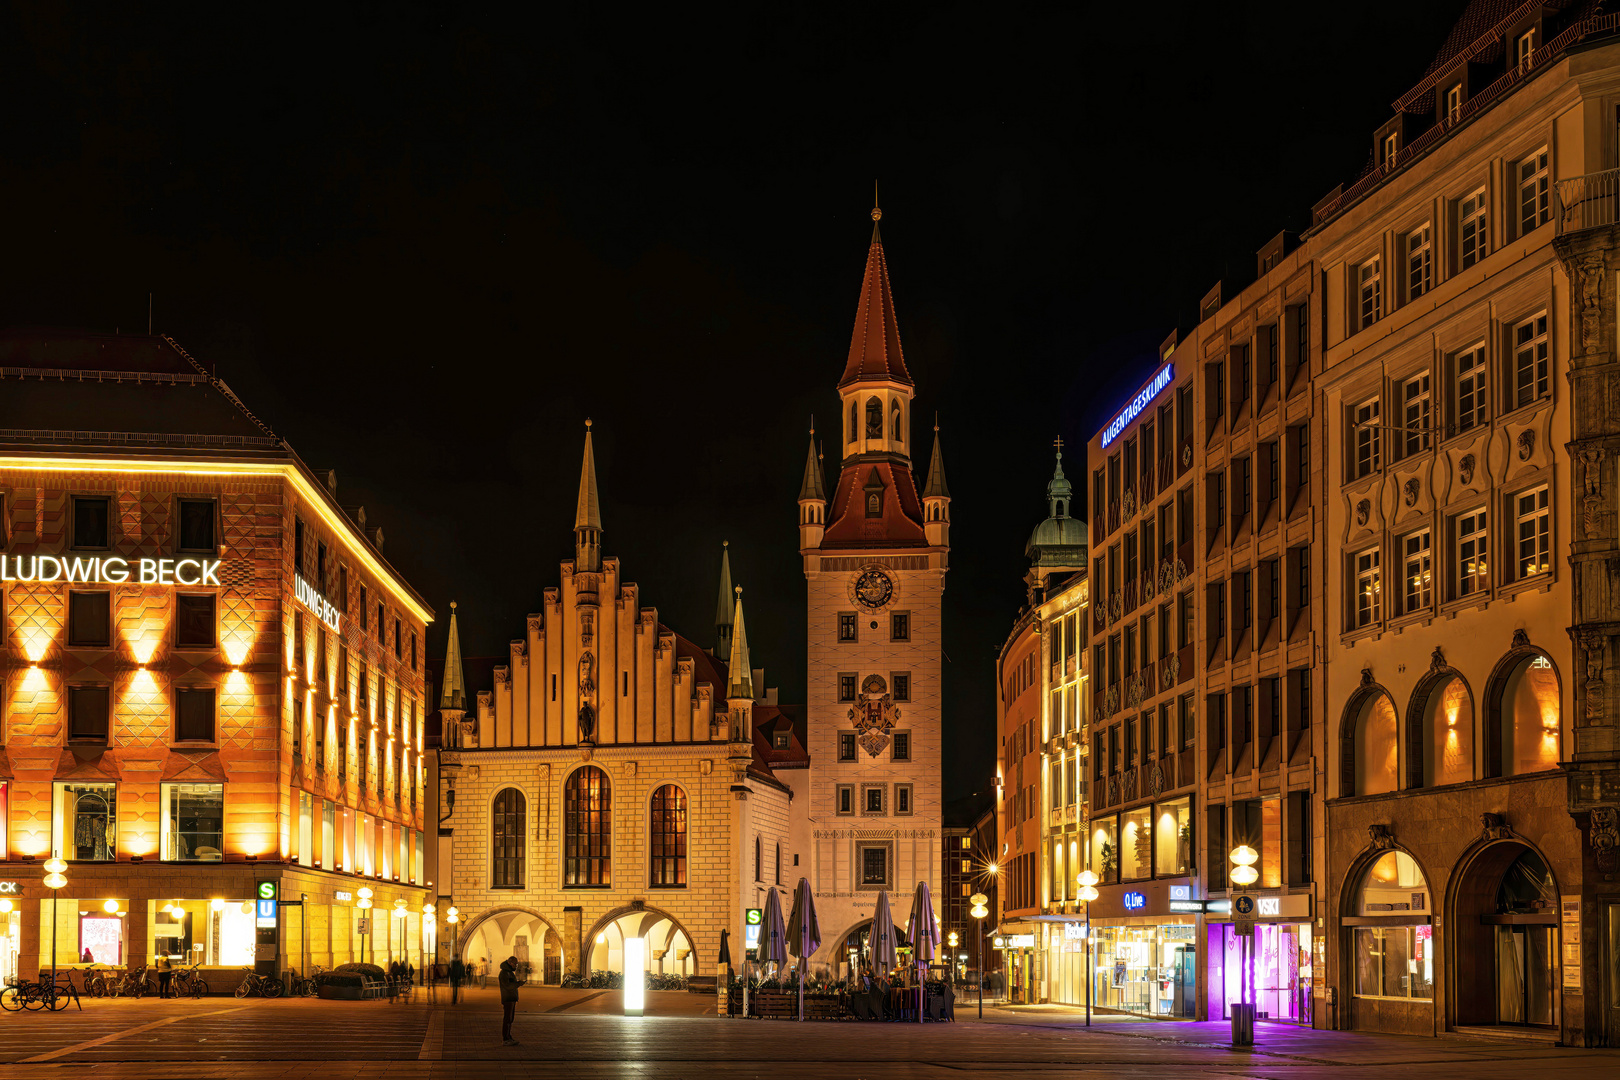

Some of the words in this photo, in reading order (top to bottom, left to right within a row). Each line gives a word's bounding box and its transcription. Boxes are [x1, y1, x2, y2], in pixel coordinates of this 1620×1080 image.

[1102, 363, 1171, 449] AUGENTAGESKLINIK
[1, 555, 130, 584] LUDWIG
[140, 558, 222, 585] BECK
[295, 573, 323, 618] LUDWIG
[323, 599, 341, 635] BECK
[261, 883, 274, 897] S
[1131, 892, 1143, 907] Live
[260, 901, 273, 917] U
[748, 910, 760, 924] S
